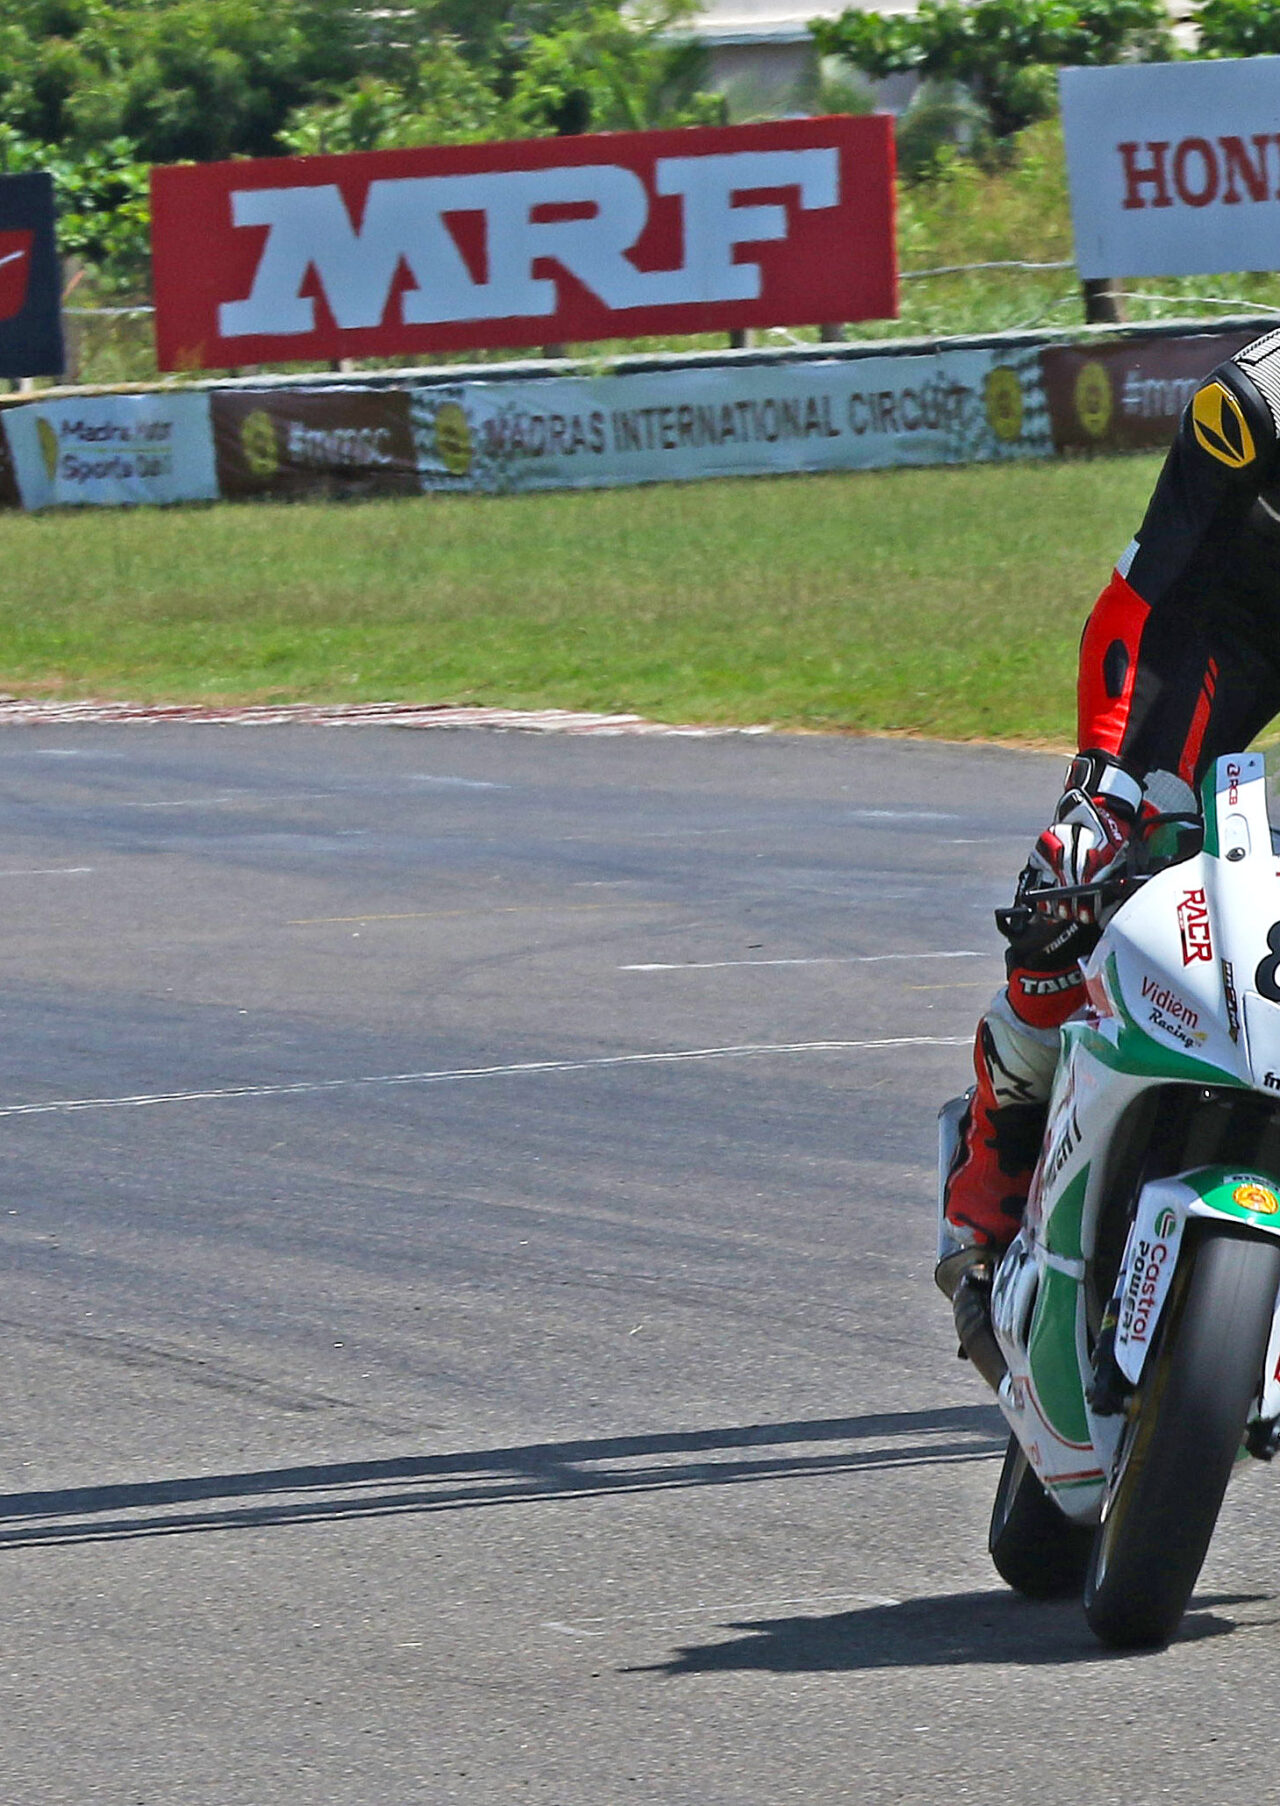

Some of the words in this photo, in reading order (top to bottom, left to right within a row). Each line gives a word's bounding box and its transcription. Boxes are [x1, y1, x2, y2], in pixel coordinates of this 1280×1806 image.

[218, 147, 841, 337] MRF
[612, 394, 841, 452] INTERNATIONAL
[1177, 887, 1213, 967] RACR
[1130, 1243, 1168, 1343] Castrol
